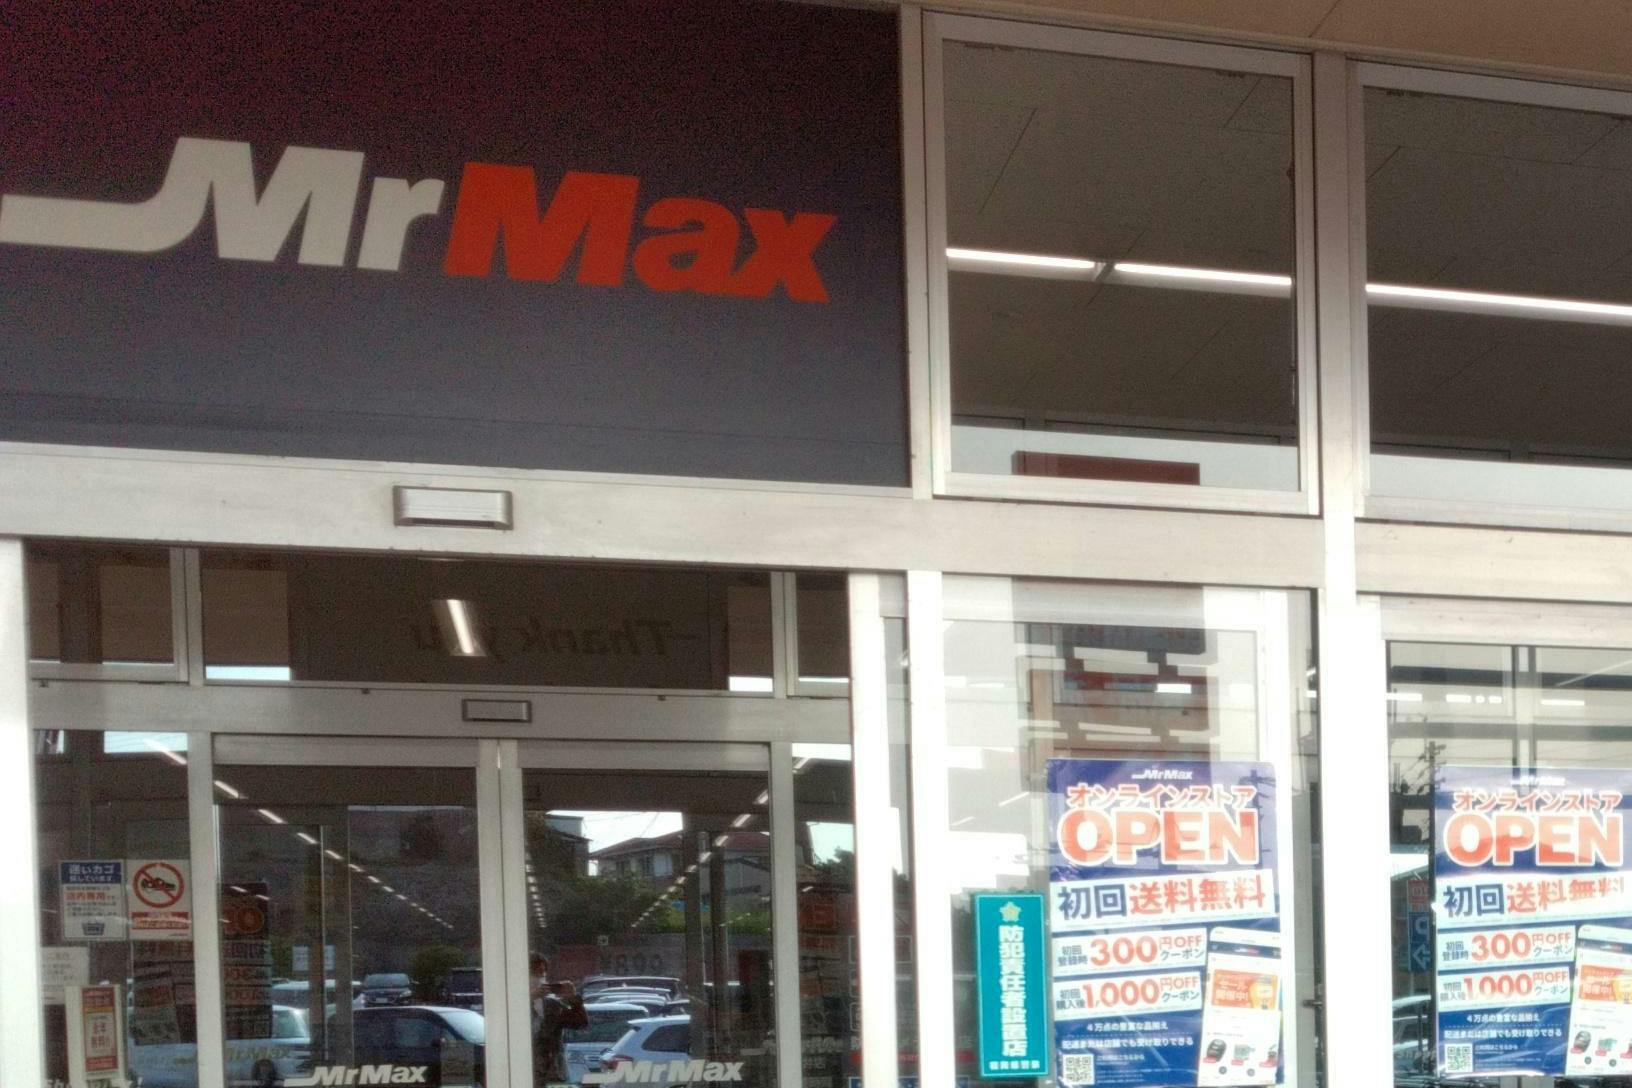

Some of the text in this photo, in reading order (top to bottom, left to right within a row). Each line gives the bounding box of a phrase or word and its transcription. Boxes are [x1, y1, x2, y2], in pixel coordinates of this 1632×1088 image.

[0, 136, 836, 305] MrMax
[1067, 782, 1257, 809] オンラインストア
[1452, 789, 1623, 813] オンラインストア
[1057, 807, 1260, 866] OPEN
[1443, 812, 1624, 867] OPEN
[1058, 875, 1266, 921] 初回送料無料
[1090, 935, 1158, 967] 300
[1159, 934, 1203, 950] 円OFF
[1471, 932, 1532, 962] 300
[1532, 932, 1572, 946] 円OFF
[1533, 944, 1574, 957] クーポン
[1160, 947, 1204, 961] クーポン
[1160, 976, 1199, 991] 円OFF
[283, 1064, 429, 1087] MrMax
[581, 1059, 745, 1085] MrMax
